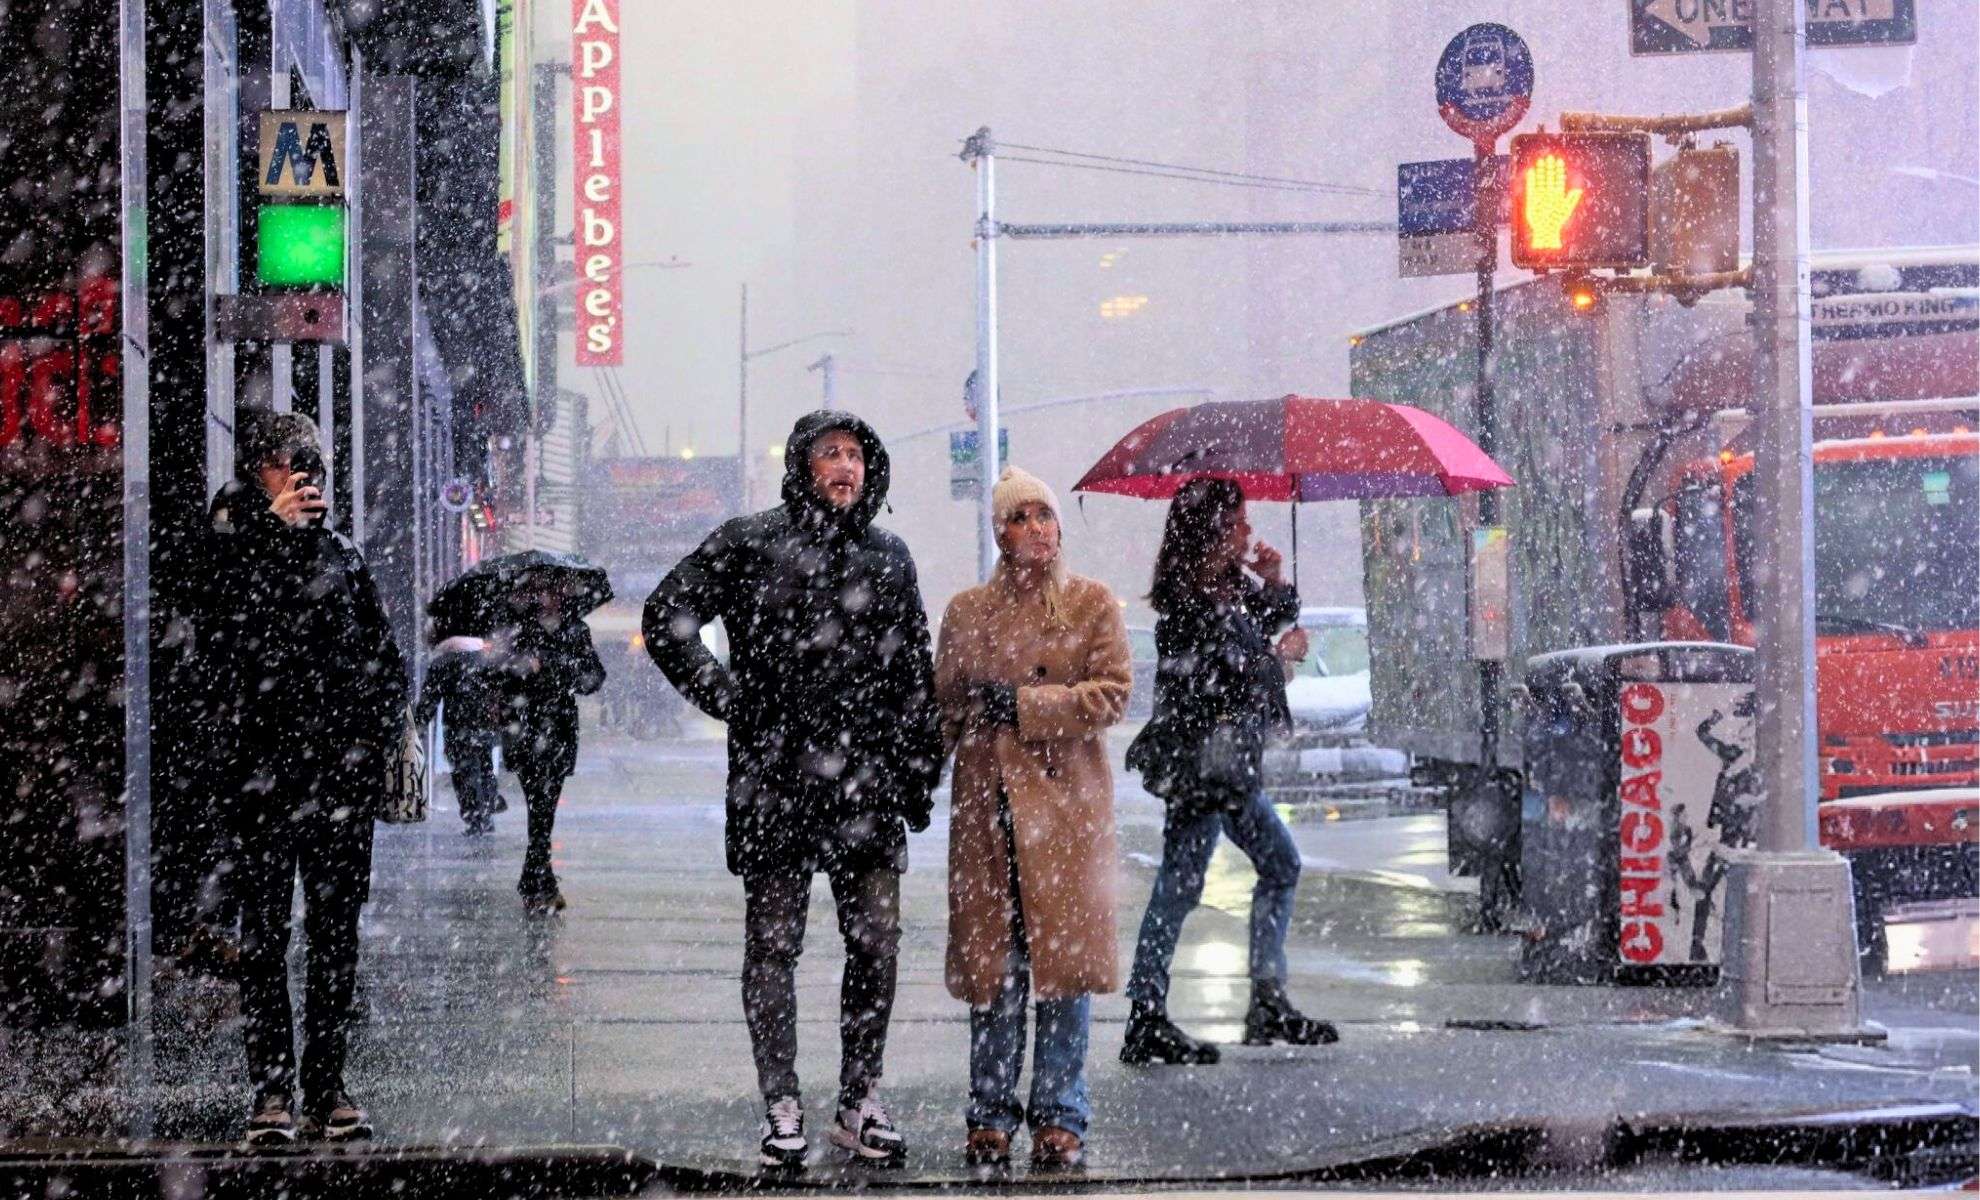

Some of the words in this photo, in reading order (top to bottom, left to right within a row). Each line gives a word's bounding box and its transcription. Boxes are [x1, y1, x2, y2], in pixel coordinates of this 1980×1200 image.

[266, 122, 340, 187] M
[573, 0, 618, 353] Applebee's
[1904, 299, 1955, 315] KING
[1619, 682, 1664, 963] CHICAGO
